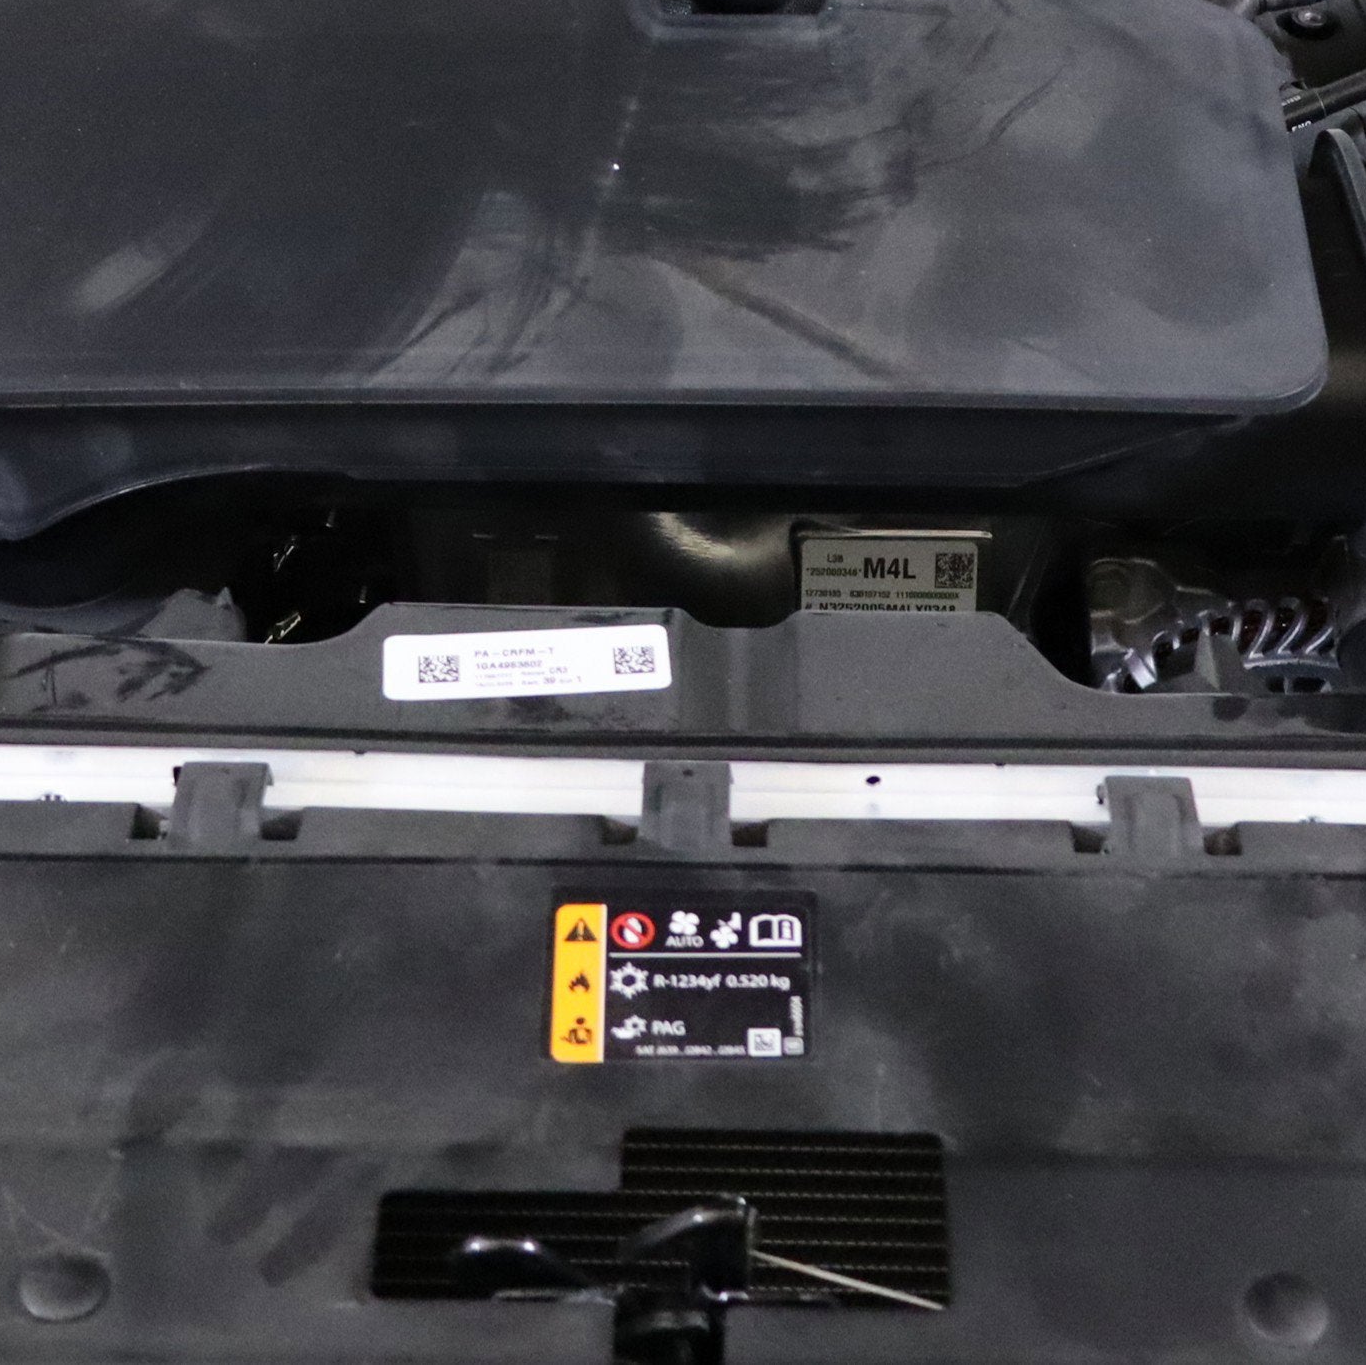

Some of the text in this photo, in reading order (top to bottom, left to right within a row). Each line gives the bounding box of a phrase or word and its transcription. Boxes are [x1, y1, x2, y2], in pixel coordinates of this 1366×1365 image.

[863, 557, 917, 580] M4L
[665, 935, 704, 949] AUTO
[653, 973, 791, 992] R-1234yf 0.520 kg
[651, 1020, 686, 1036] PAG
